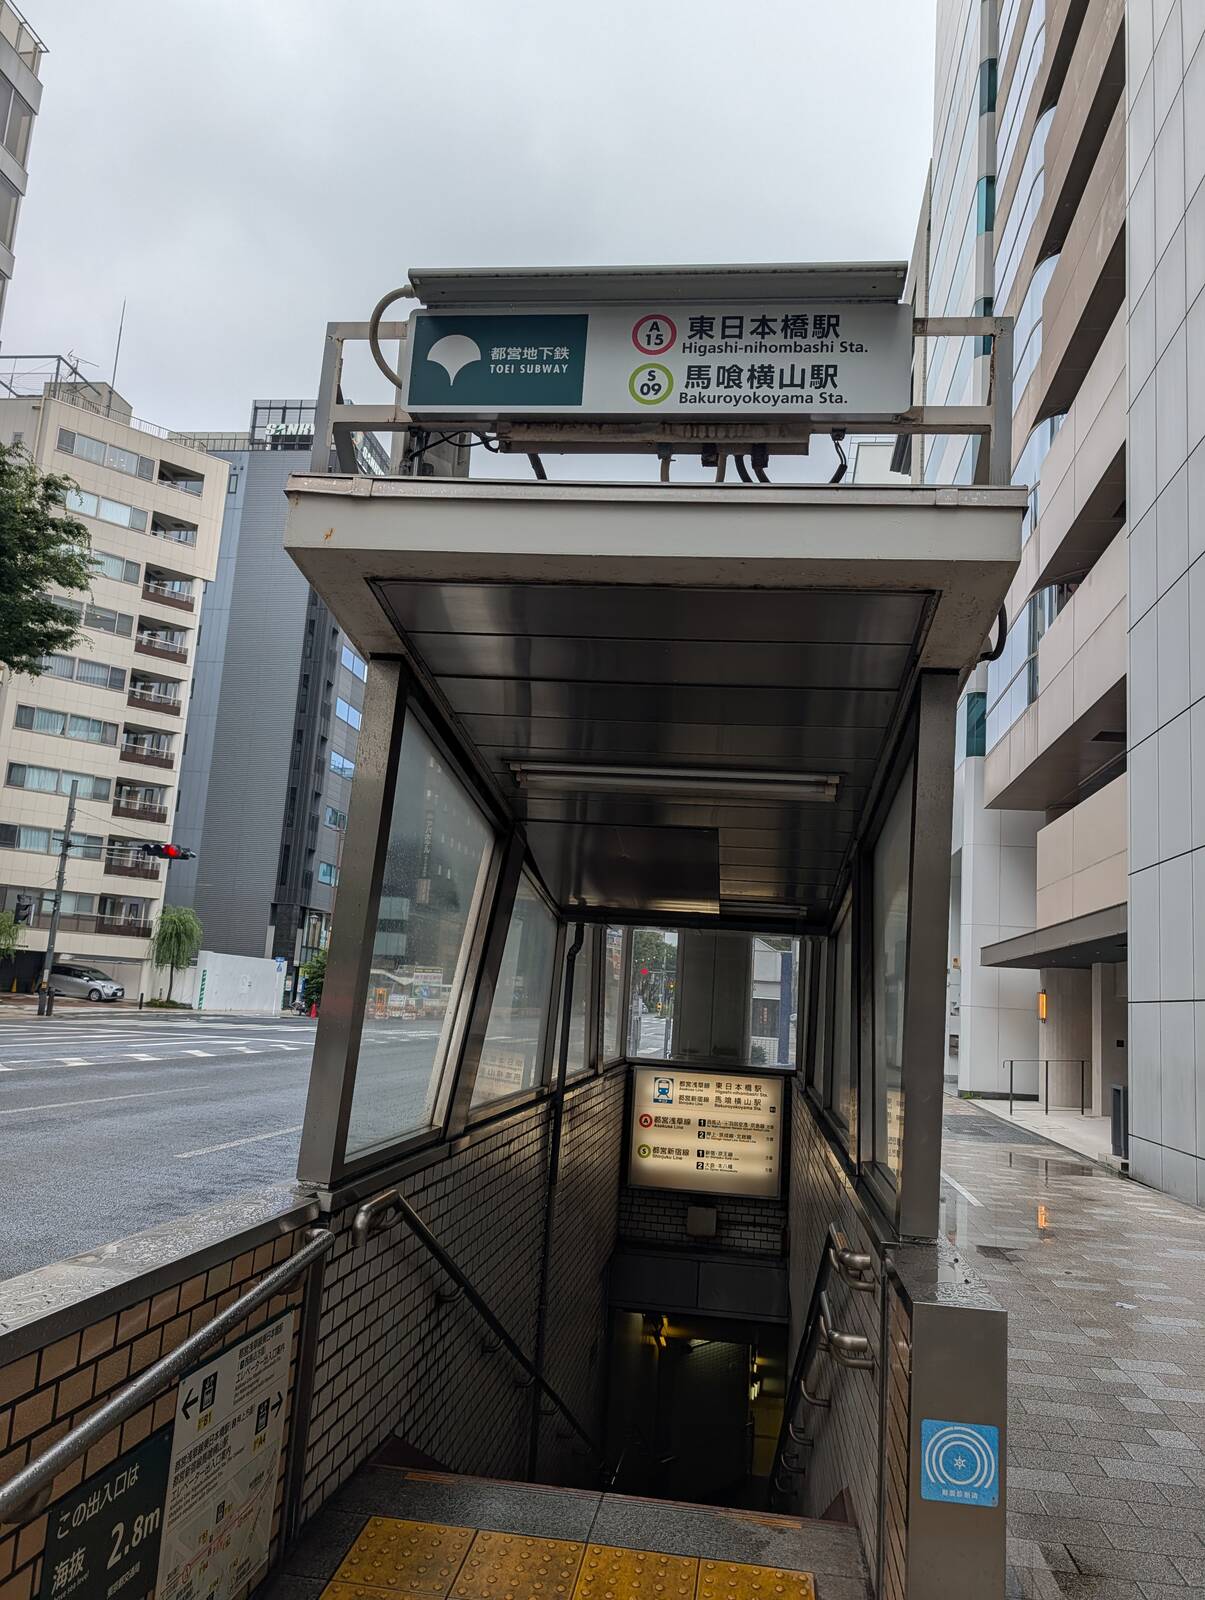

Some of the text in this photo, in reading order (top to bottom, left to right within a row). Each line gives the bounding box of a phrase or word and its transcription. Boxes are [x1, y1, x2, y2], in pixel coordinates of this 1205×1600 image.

[649, 320, 661, 332] A
[687, 313, 841, 340] 東日本橋駅
[645, 333, 664, 346] 15
[490, 346, 570, 361] 都営地下鉄
[682, 340, 868, 357] Higashi-nihombashi Sta.
[490, 364, 568, 374] TOEI SUBWAY
[647, 370, 657, 382] S
[684, 363, 838, 390] 馬喰横山駅
[639, 383, 662, 396] 09
[679, 392, 848, 407] Bakuroyokoyama Sta.
[715, 1081, 762, 1092] 東日本橋駅
[714, 1095, 762, 1107] 馬喰横山駅
[56, 1462, 141, 1540] この出入口は
[106, 1506, 161, 1570] 2.8m
[51, 1546, 87, 1595] 海抜
